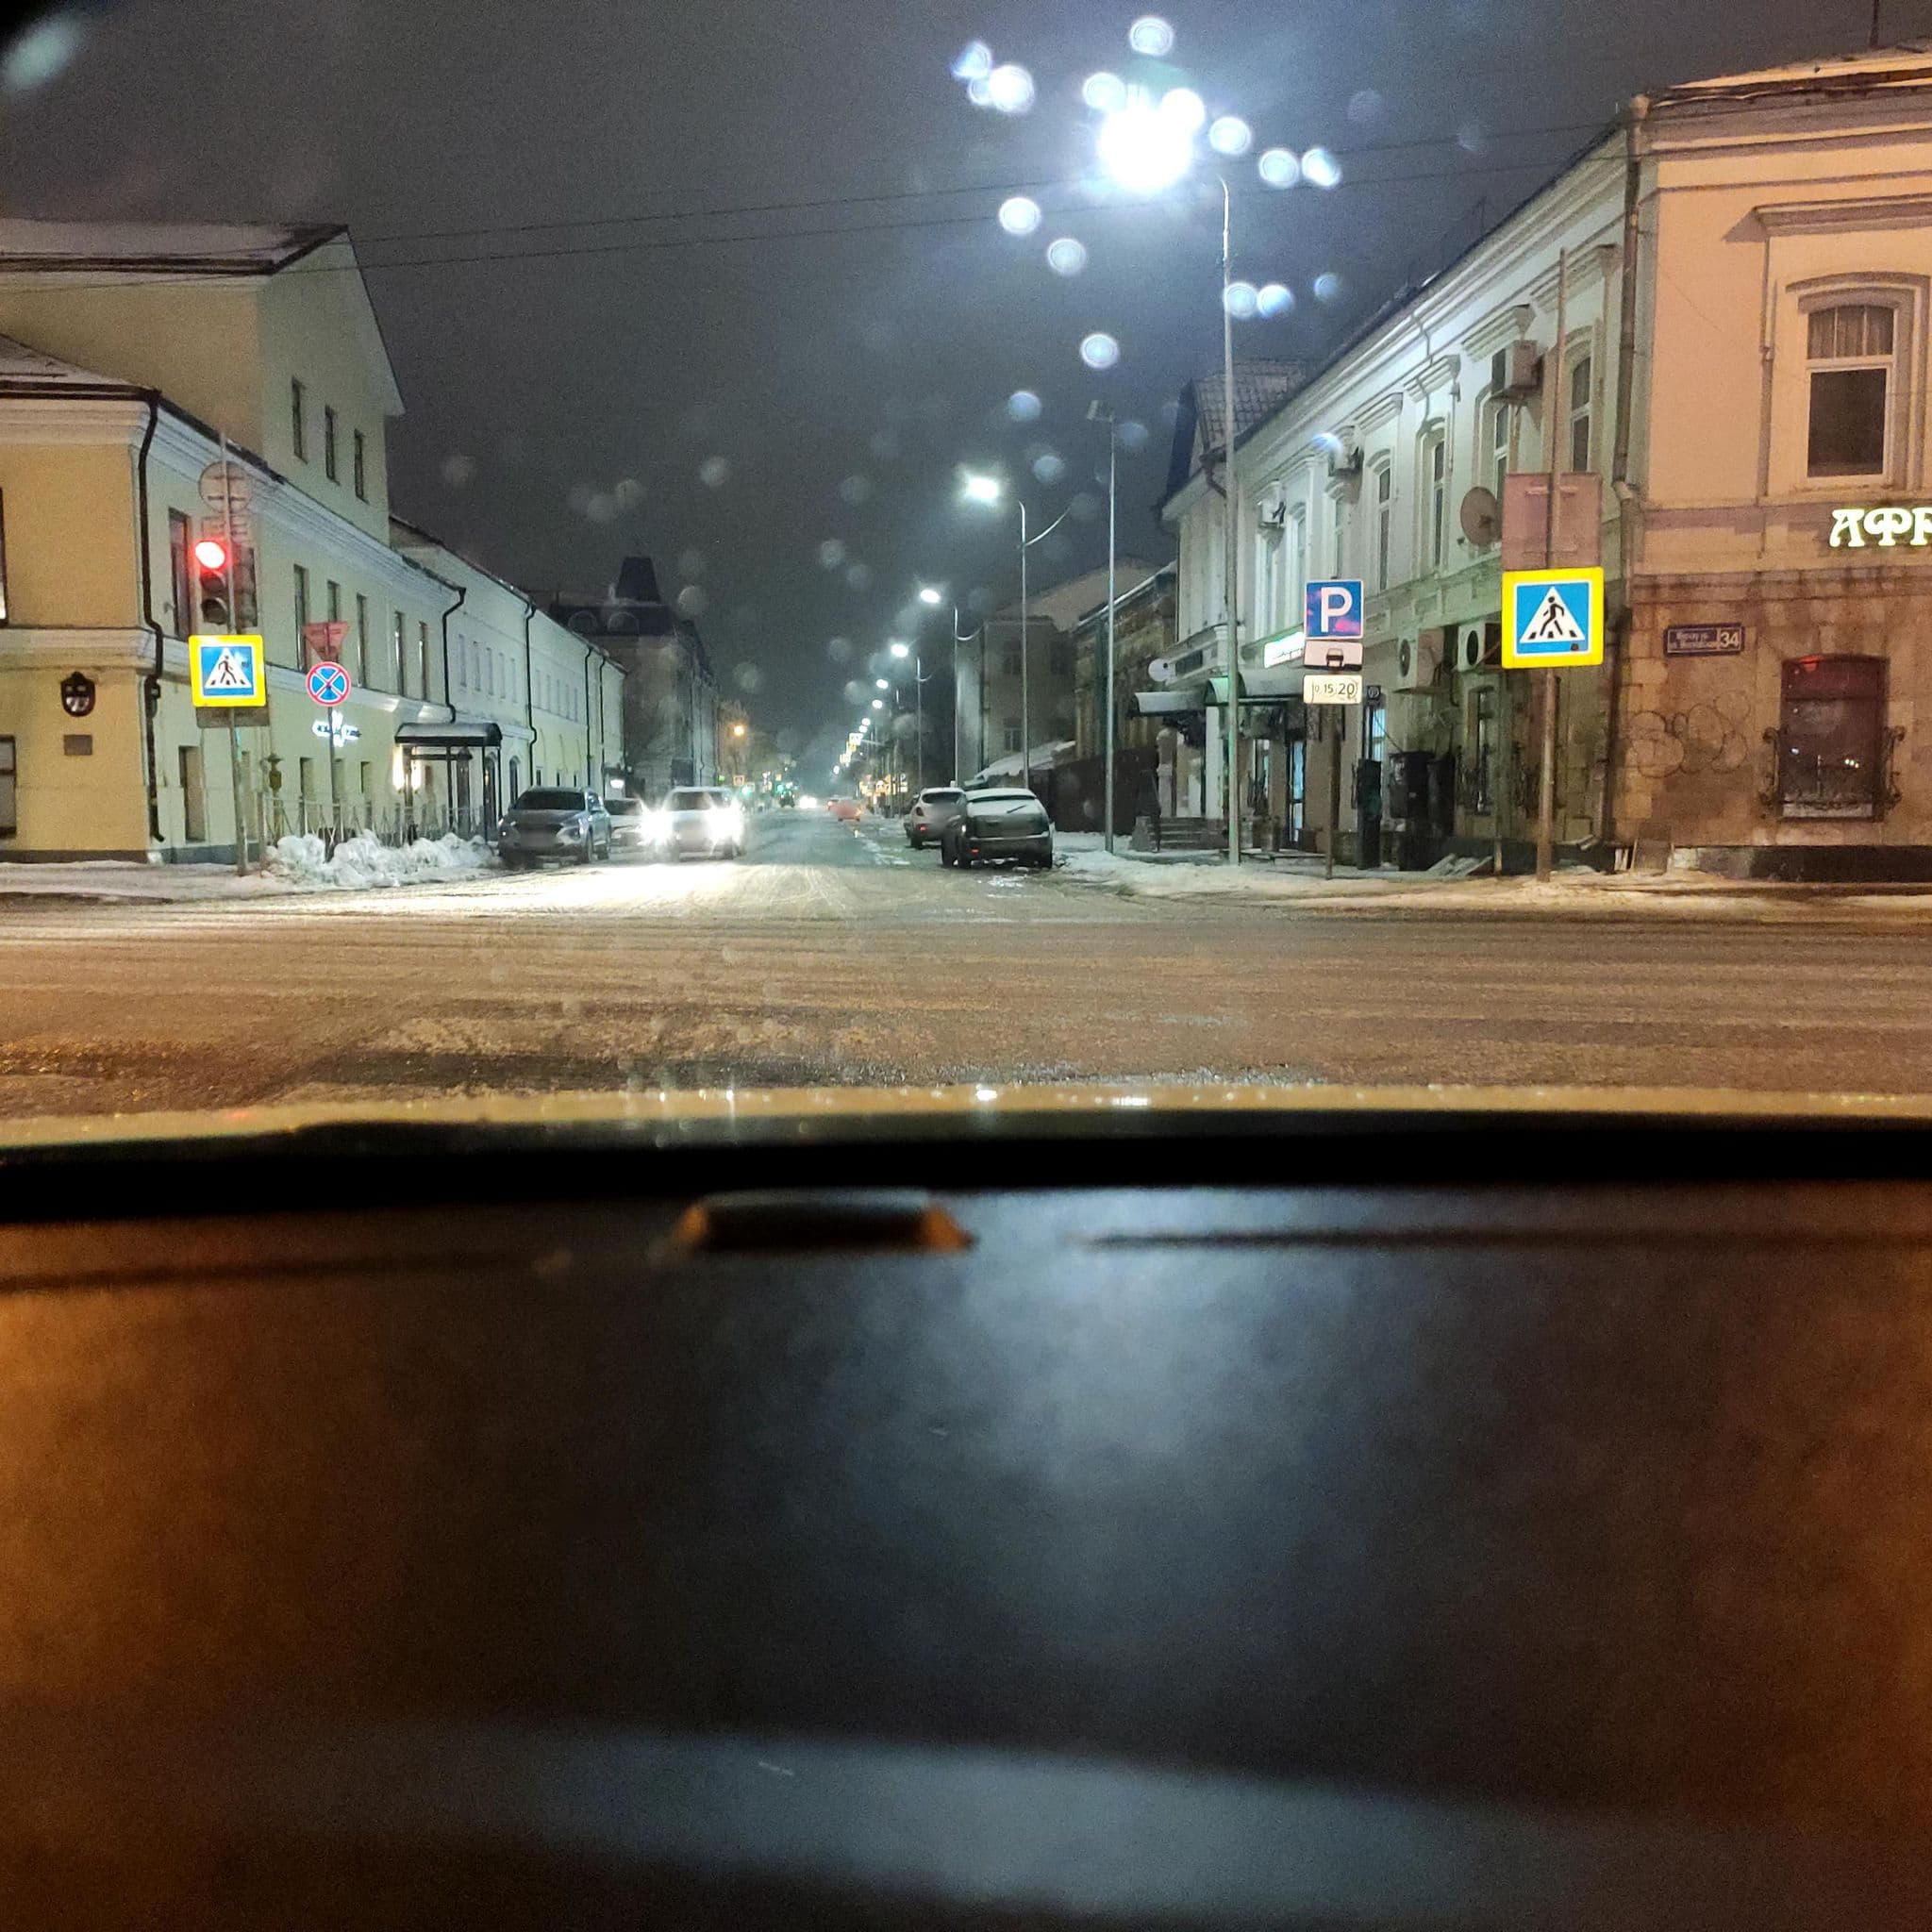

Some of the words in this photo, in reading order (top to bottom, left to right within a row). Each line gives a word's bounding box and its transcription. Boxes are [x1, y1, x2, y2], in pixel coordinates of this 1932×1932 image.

[1321, 587, 1353, 633] P
[1720, 630, 1740, 648] 34
[1338, 682, 1356, 695] 20
